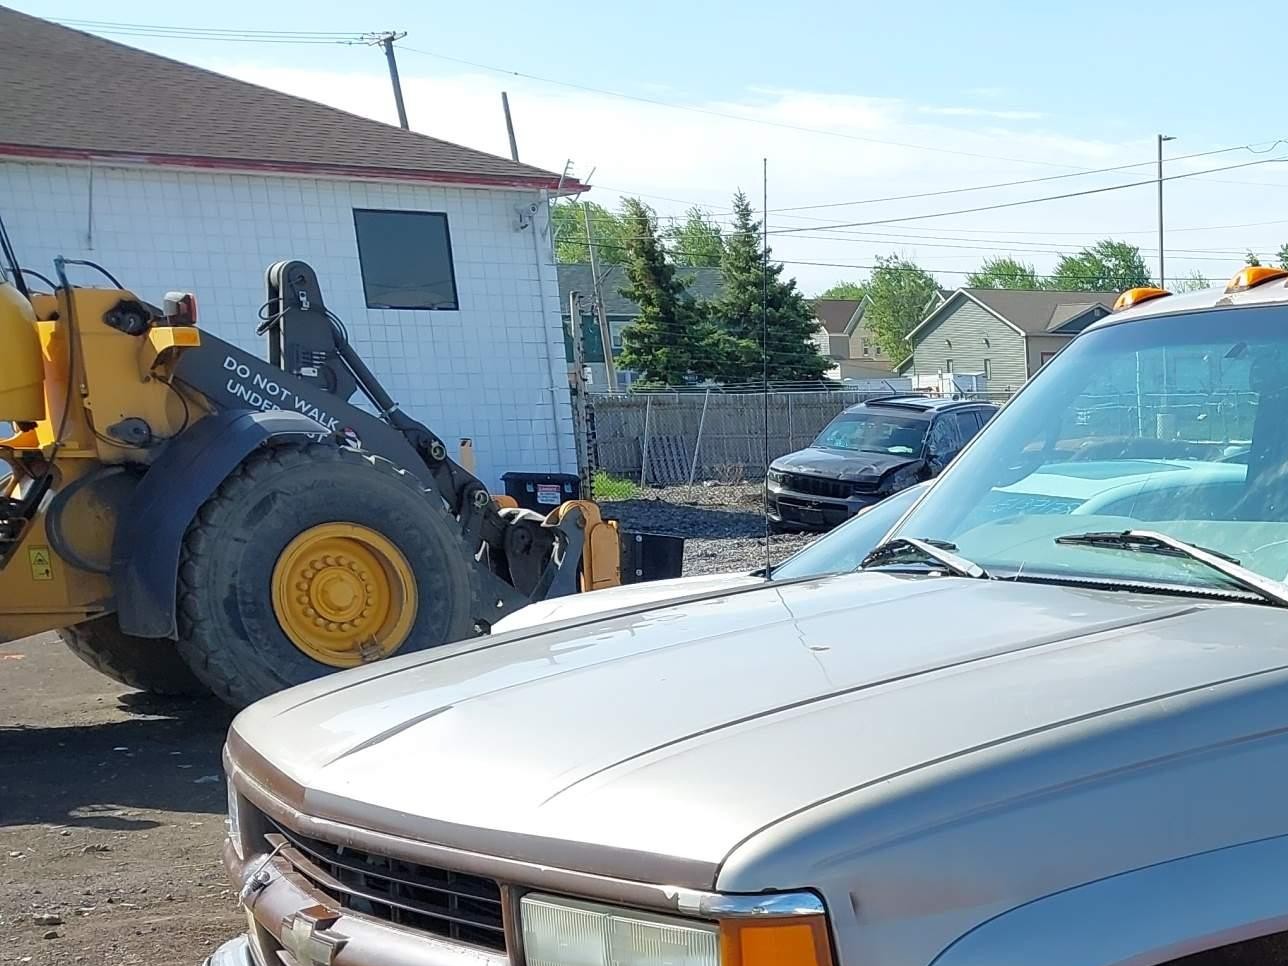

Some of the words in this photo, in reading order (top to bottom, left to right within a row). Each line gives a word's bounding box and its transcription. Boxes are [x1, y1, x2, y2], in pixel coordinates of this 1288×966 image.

[223, 356, 251, 378] DO
[252, 373, 292, 401] NOT
[294, 396, 339, 431] WALK
